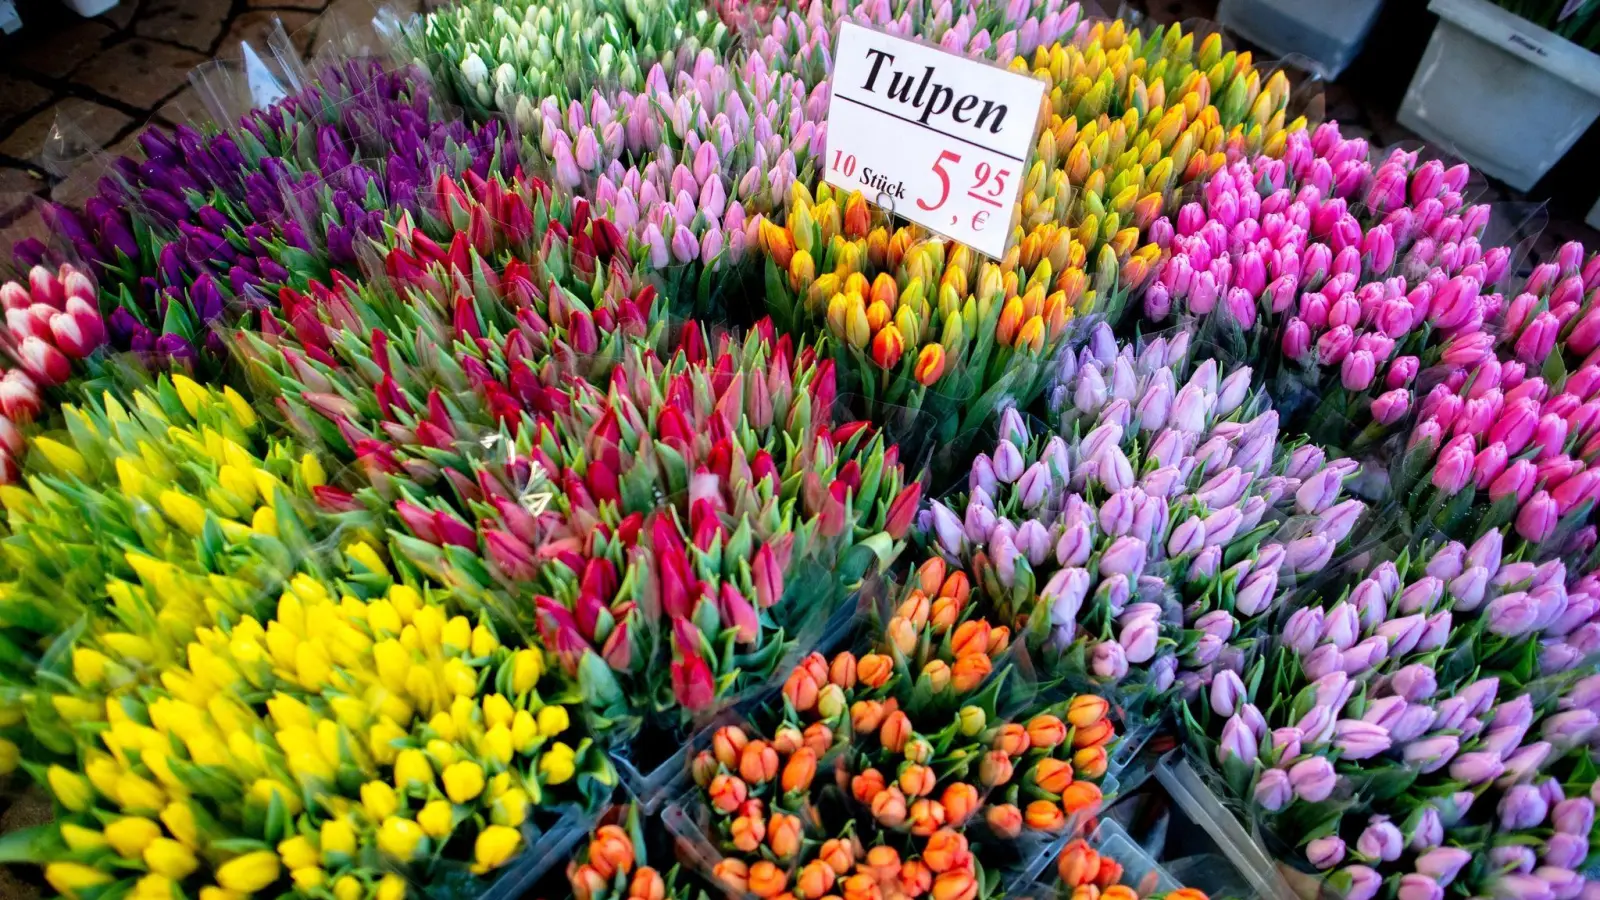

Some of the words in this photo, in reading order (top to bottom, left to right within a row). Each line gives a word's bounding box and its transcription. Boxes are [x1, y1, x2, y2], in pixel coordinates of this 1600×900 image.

[860, 48, 1008, 134] Tulpen
[831, 149, 857, 178] 10
[859, 167, 906, 200] Stück
[971, 210, 991, 232] €
